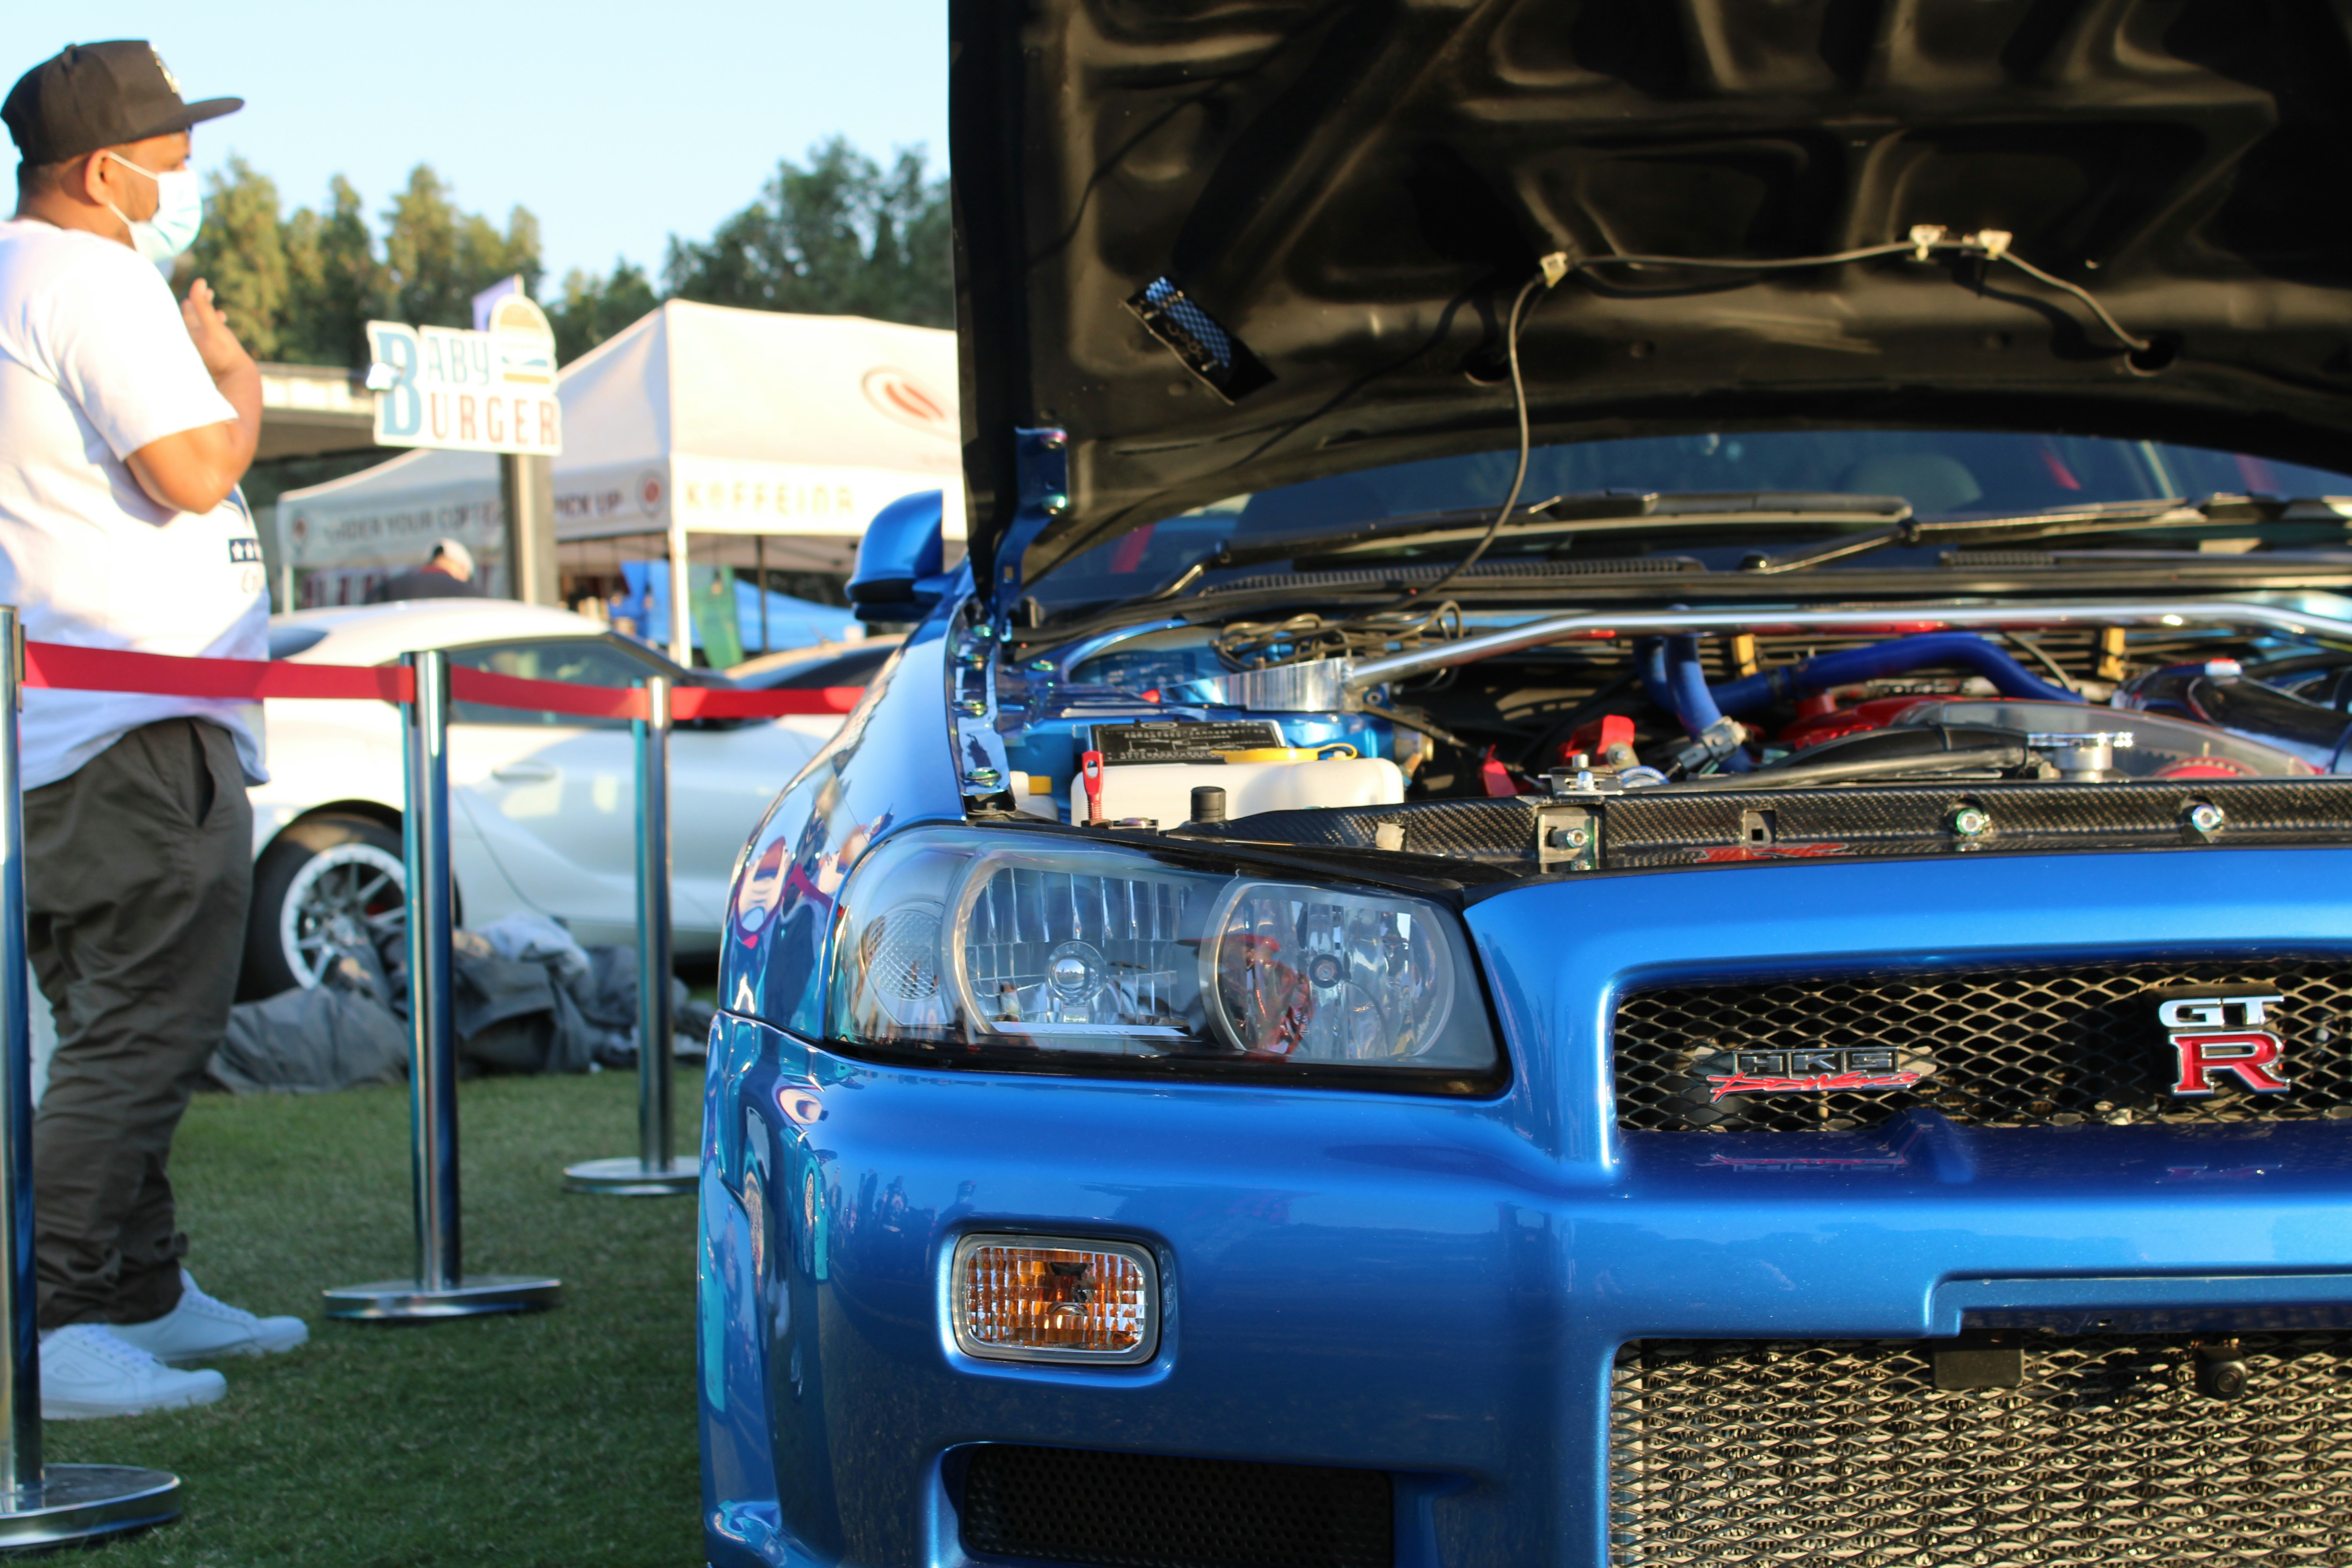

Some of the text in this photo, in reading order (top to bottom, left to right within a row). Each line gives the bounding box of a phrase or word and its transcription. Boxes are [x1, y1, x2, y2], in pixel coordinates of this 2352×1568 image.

[2158, 995, 2285, 1027] GT
[1740, 1051, 1893, 1072] HKS
[2169, 1030, 2291, 1095] R
